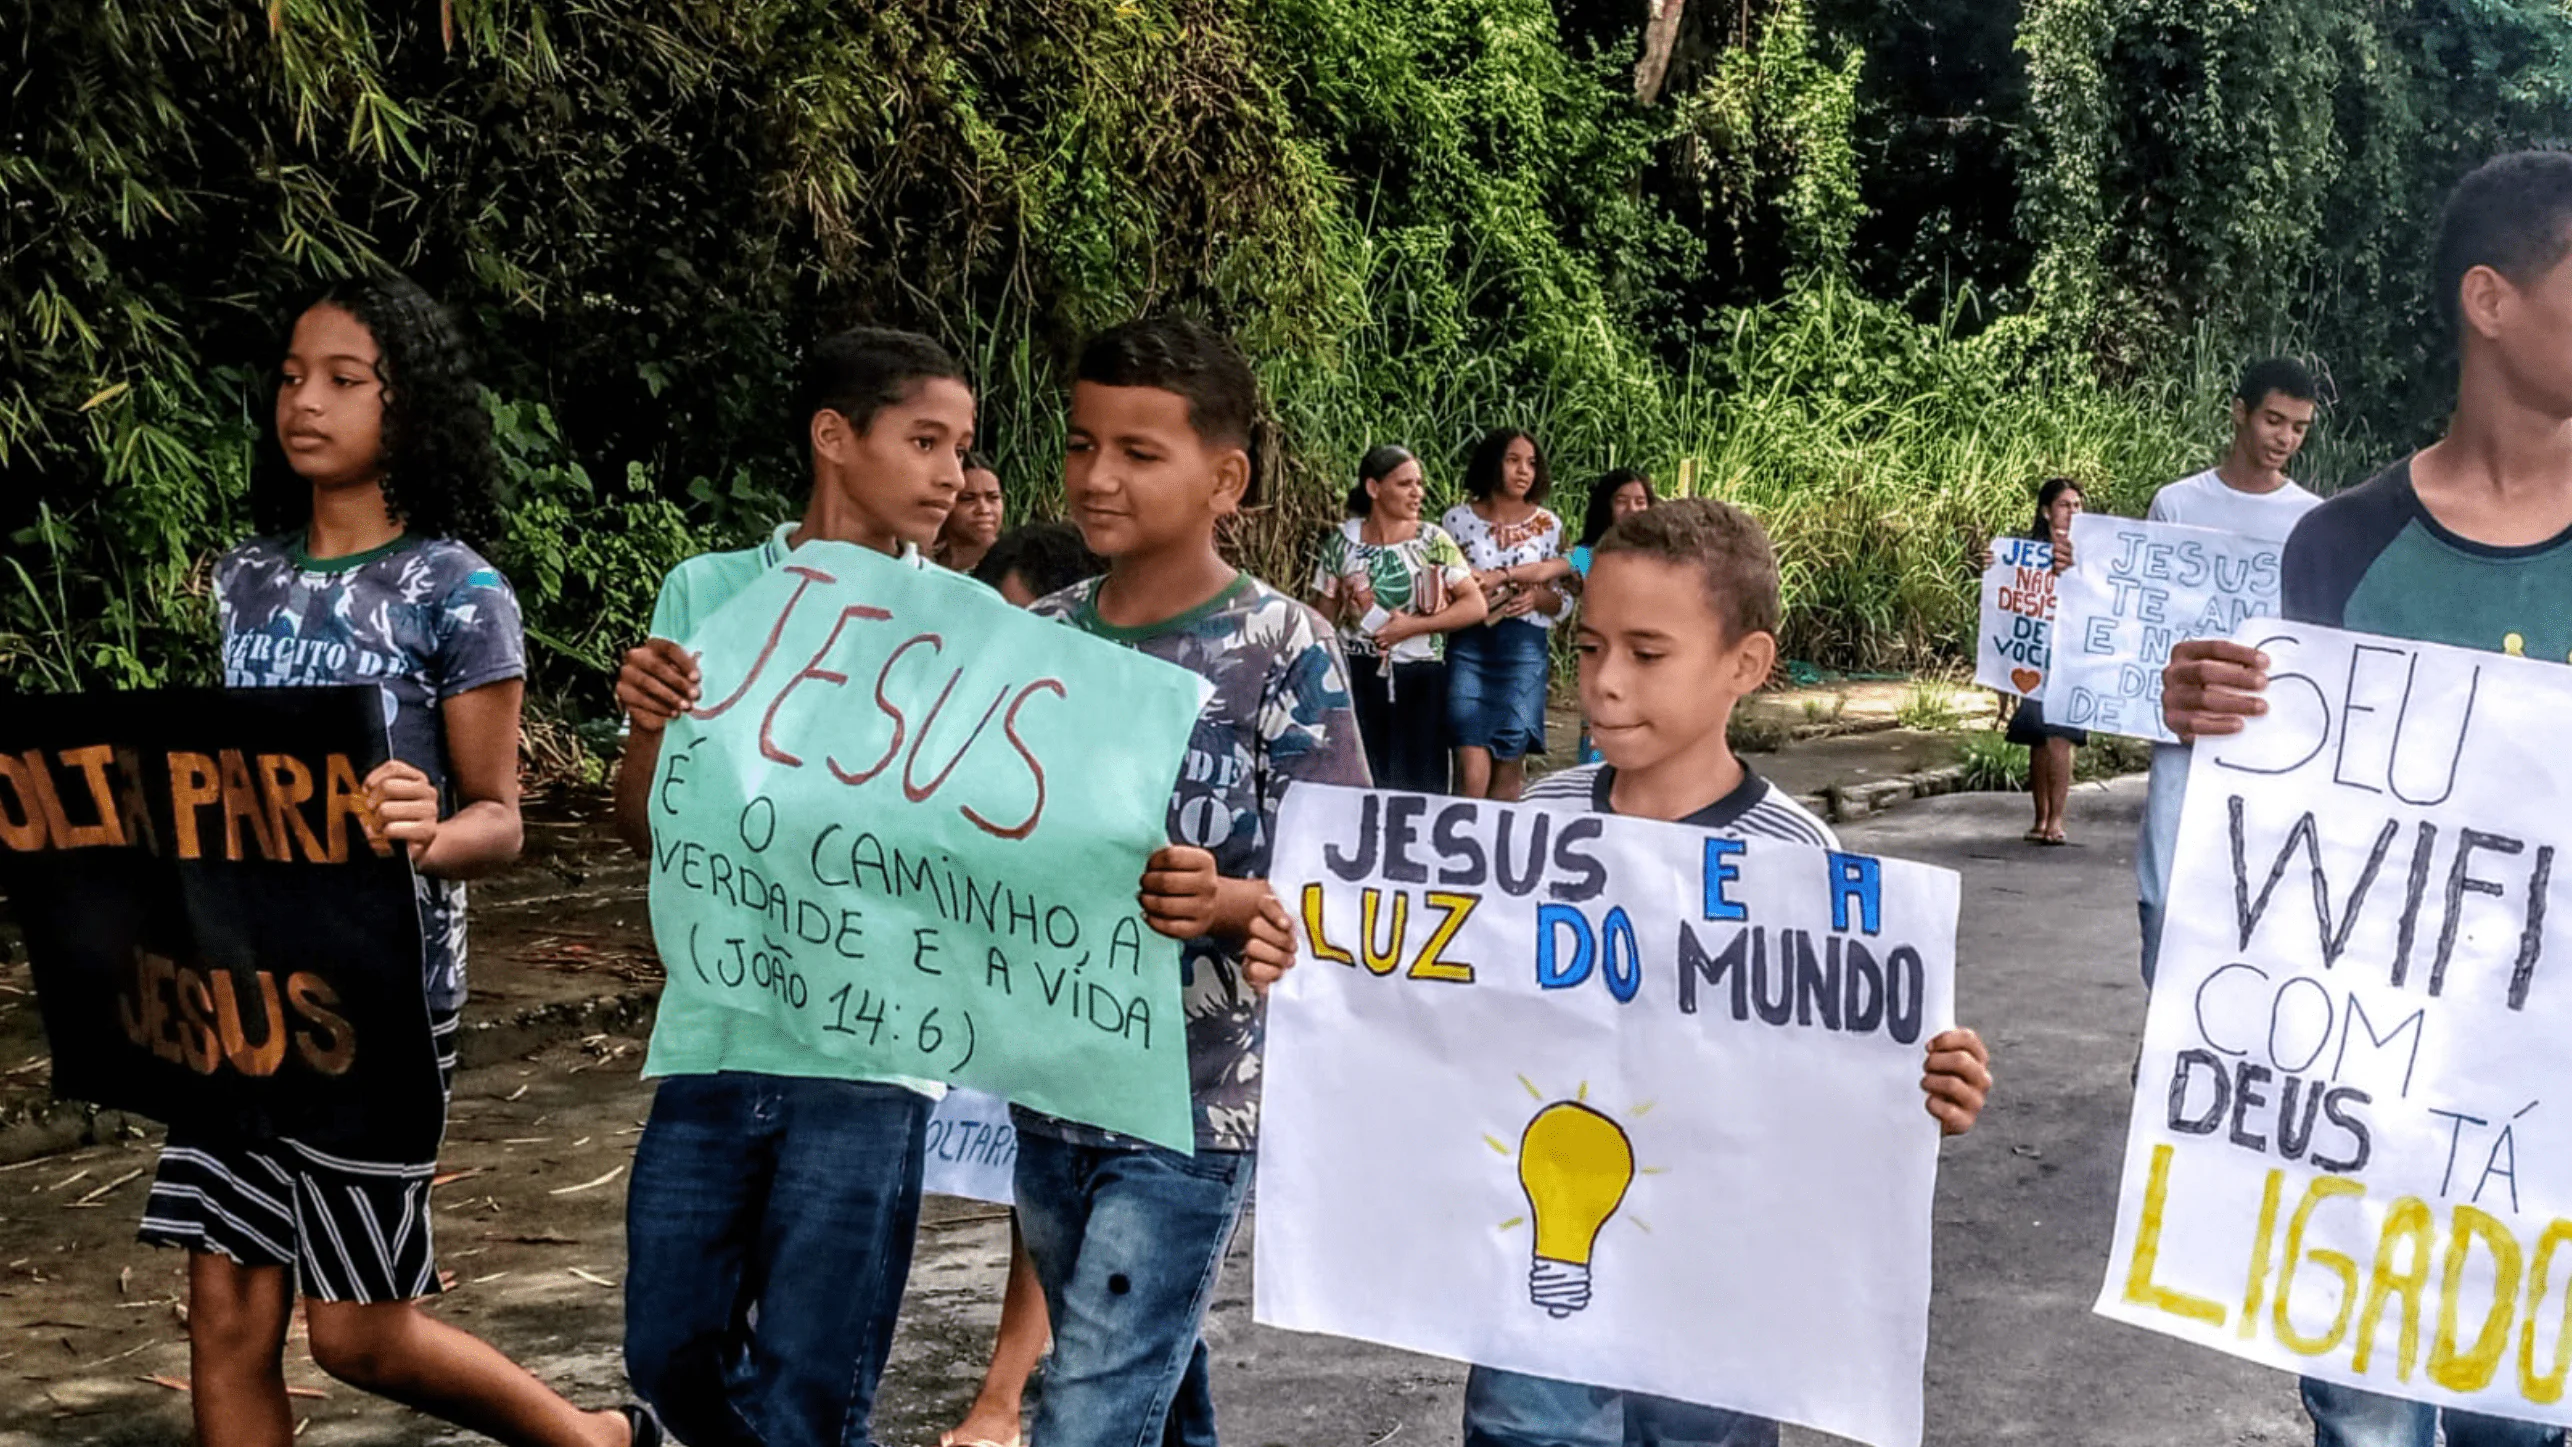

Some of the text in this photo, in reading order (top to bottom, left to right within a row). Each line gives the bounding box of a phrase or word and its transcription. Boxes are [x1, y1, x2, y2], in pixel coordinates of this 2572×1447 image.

[1998, 586, 2057, 621] DESIS
[2002, 540, 2054, 569] JES
[2107, 575, 2268, 635] TE AM
[2112, 532, 2279, 594] JESUS
[1993, 635, 2051, 670] VOC
[2014, 616, 2047, 645] DE
[2084, 616, 2119, 655] E
[692, 565, 1067, 840] JESUS
[2066, 686, 2126, 733] DE
[2214, 635, 2481, 806] SEU
[0, 743, 395, 864] OLTA PARA
[662, 736, 707, 815] É
[740, 796, 775, 853] O
[1109, 915, 1141, 975] A
[1324, 795, 1607, 900] JESUS
[1825, 850, 1881, 936] A
[655, 827, 865, 958] VERDADE
[914, 929, 942, 975] E
[987, 947, 1012, 995] A
[1302, 883, 1925, 1044] LUZ DO MUNDO
[2228, 794, 2554, 1011] WIFI
[118, 945, 357, 1076] JESUS
[2196, 963, 2425, 1099] COM
[2168, 1049, 2540, 1214] DEUS TÁ
[2122, 1143, 2572, 1405] LIGADO
